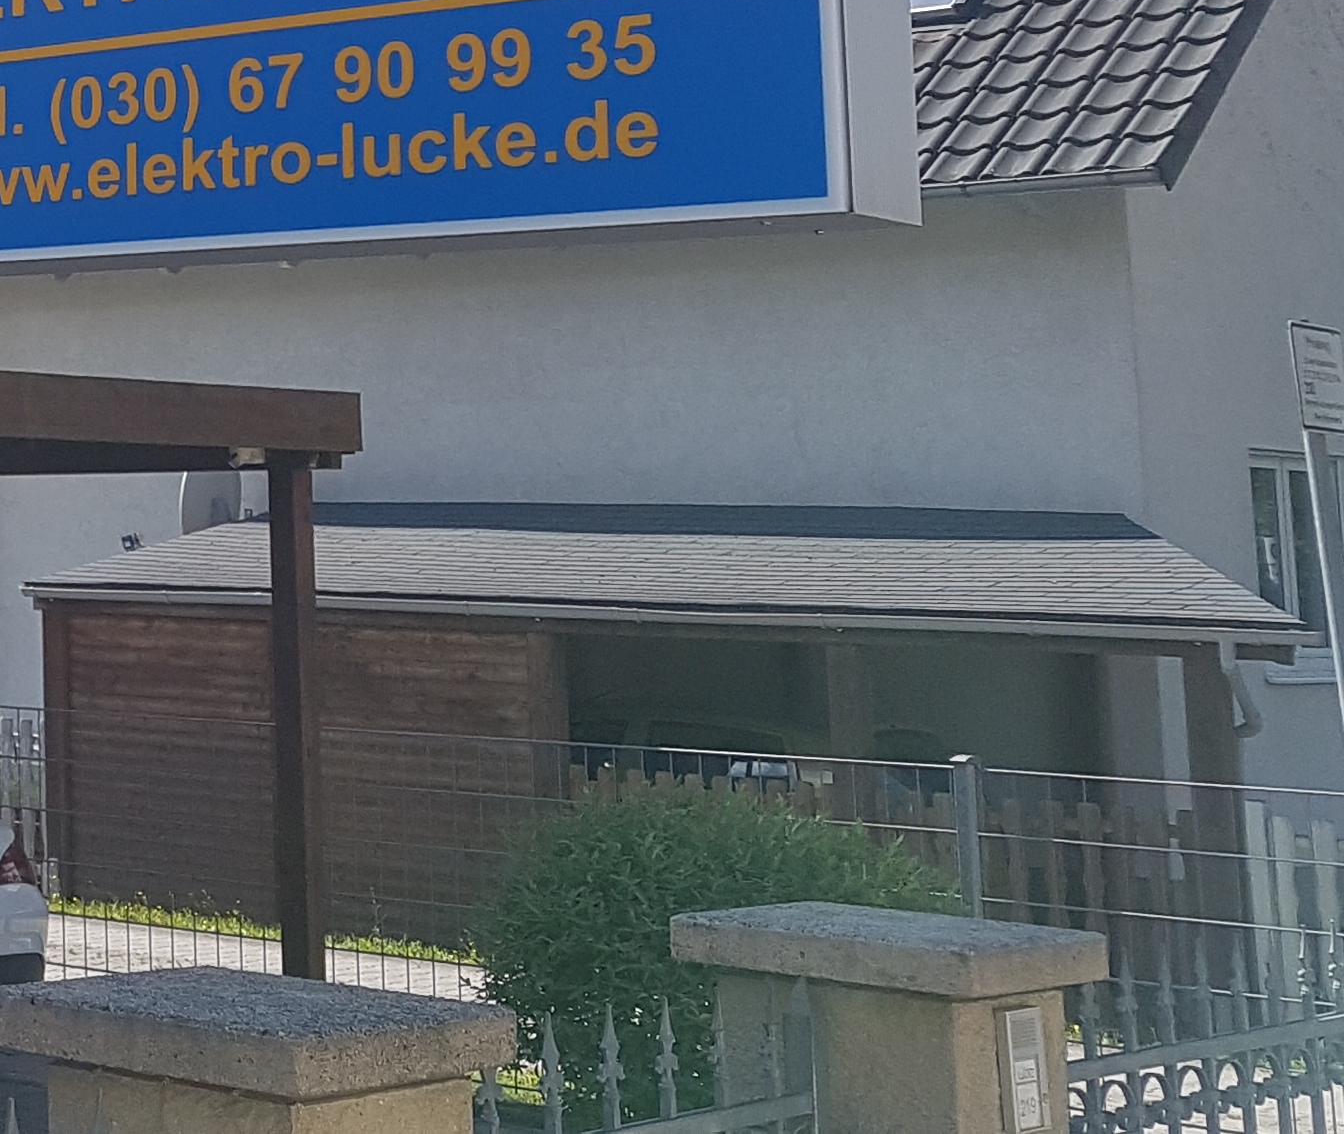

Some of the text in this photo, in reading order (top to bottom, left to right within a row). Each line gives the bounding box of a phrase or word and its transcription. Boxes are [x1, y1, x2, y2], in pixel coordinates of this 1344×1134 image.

[50, 64, 200, 145] (030)
[228, 52, 304, 114] 67
[334, 40, 415, 104] 90
[446, 28, 532, 92] 99
[567, 13, 657, 81] 35
